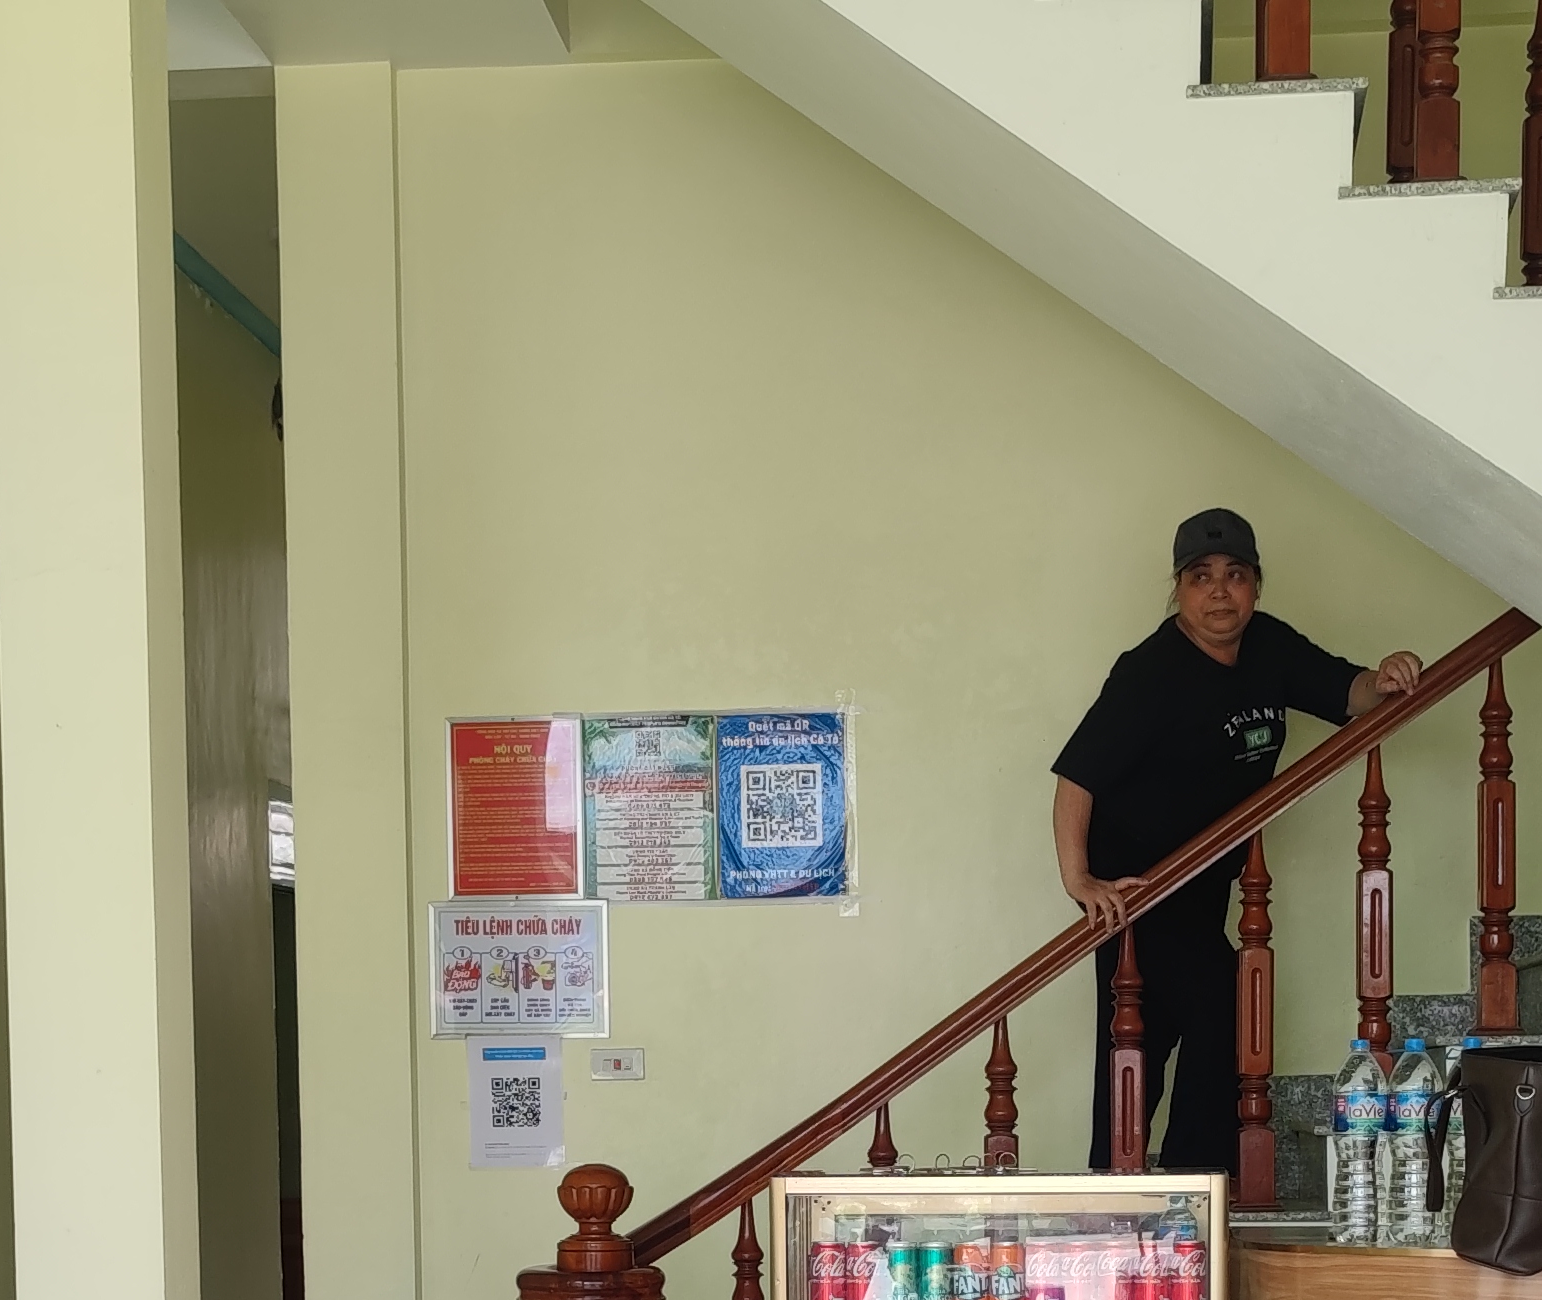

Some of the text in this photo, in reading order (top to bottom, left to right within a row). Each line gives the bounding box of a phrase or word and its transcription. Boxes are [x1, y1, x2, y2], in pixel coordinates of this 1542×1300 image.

[513, 744, 533, 755] QUY
[454, 914, 582, 939] TIÊU LỆNH CHỮA CHÁY
[496, 949, 504, 957] 2
[1348, 1103, 1384, 1119] laVie
